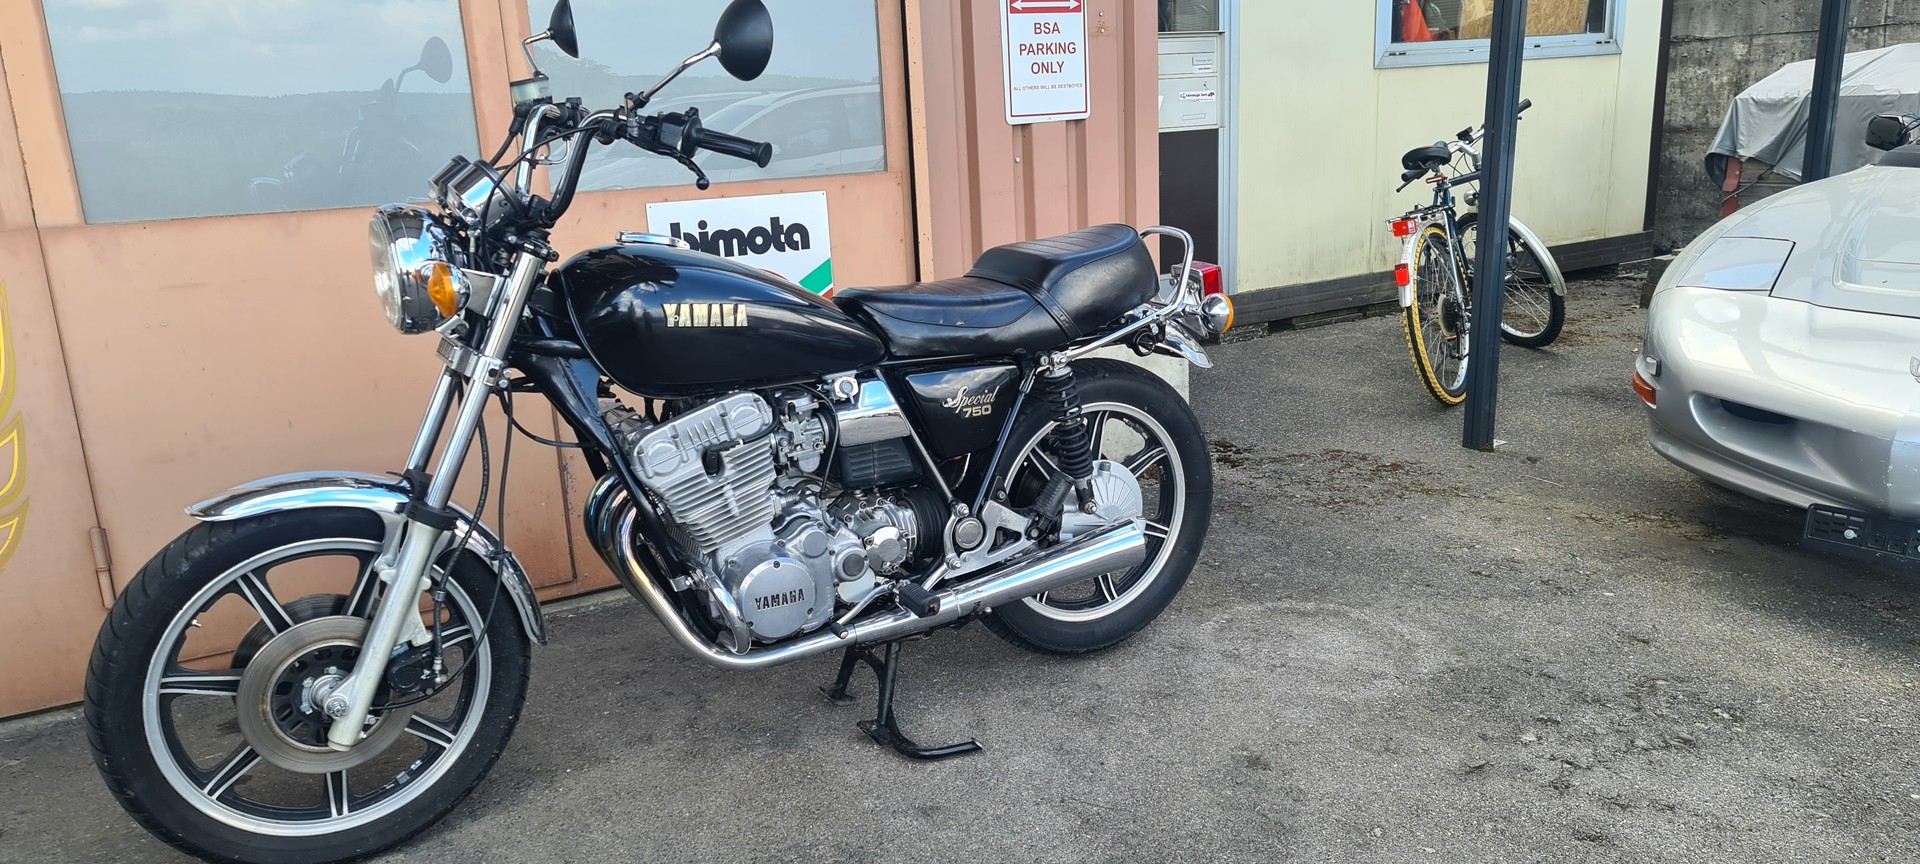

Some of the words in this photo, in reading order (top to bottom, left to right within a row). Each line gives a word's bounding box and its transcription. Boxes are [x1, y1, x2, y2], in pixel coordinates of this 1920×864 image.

[1034, 22, 1060, 34] BSA
[1019, 42, 1077, 56] PARKING
[1031, 61, 1065, 74] ONLY
[942, 385, 1000, 414] Special
[963, 404, 992, 418] 750
[755, 588, 805, 610] YAMAHA
